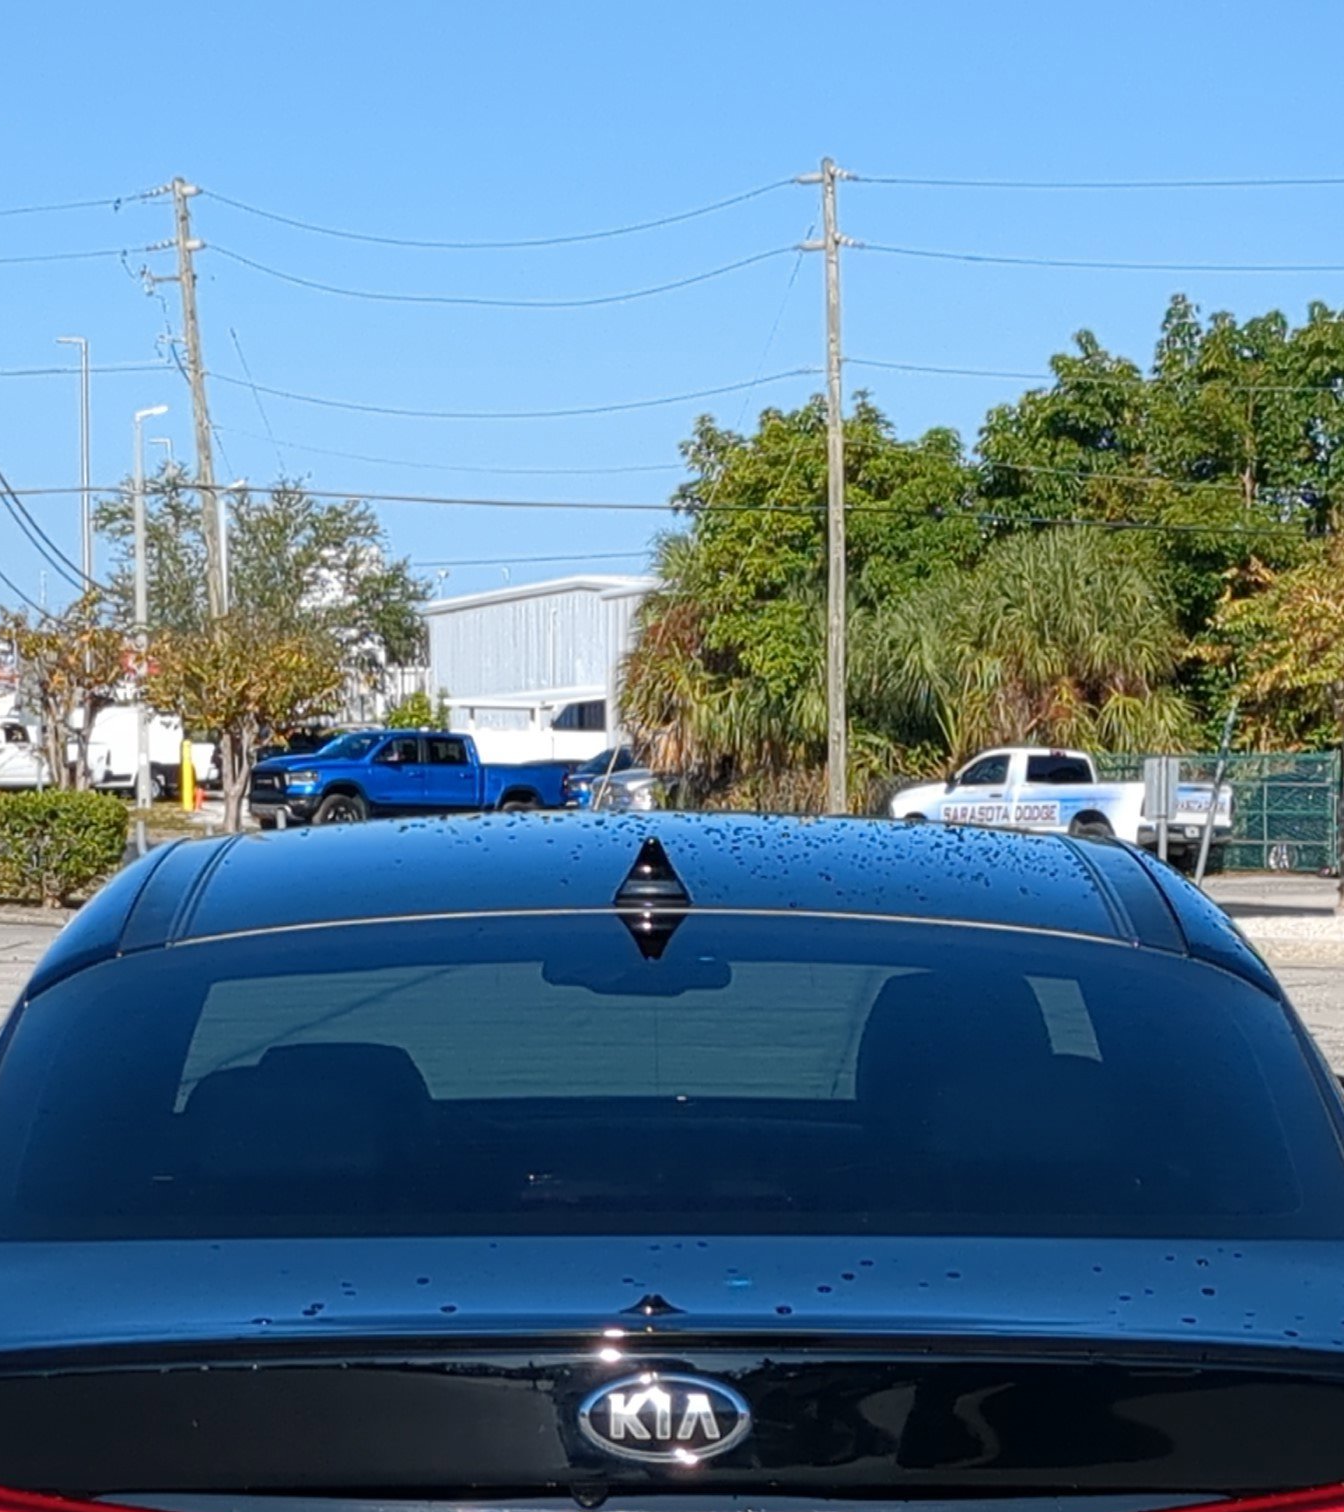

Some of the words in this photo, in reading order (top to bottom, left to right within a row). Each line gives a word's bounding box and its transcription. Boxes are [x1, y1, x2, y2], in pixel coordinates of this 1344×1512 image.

[943, 805, 1010, 823] SARASOTA
[1014, 804, 1057, 822] DODGE
[608, 1391, 721, 1439] KIA
